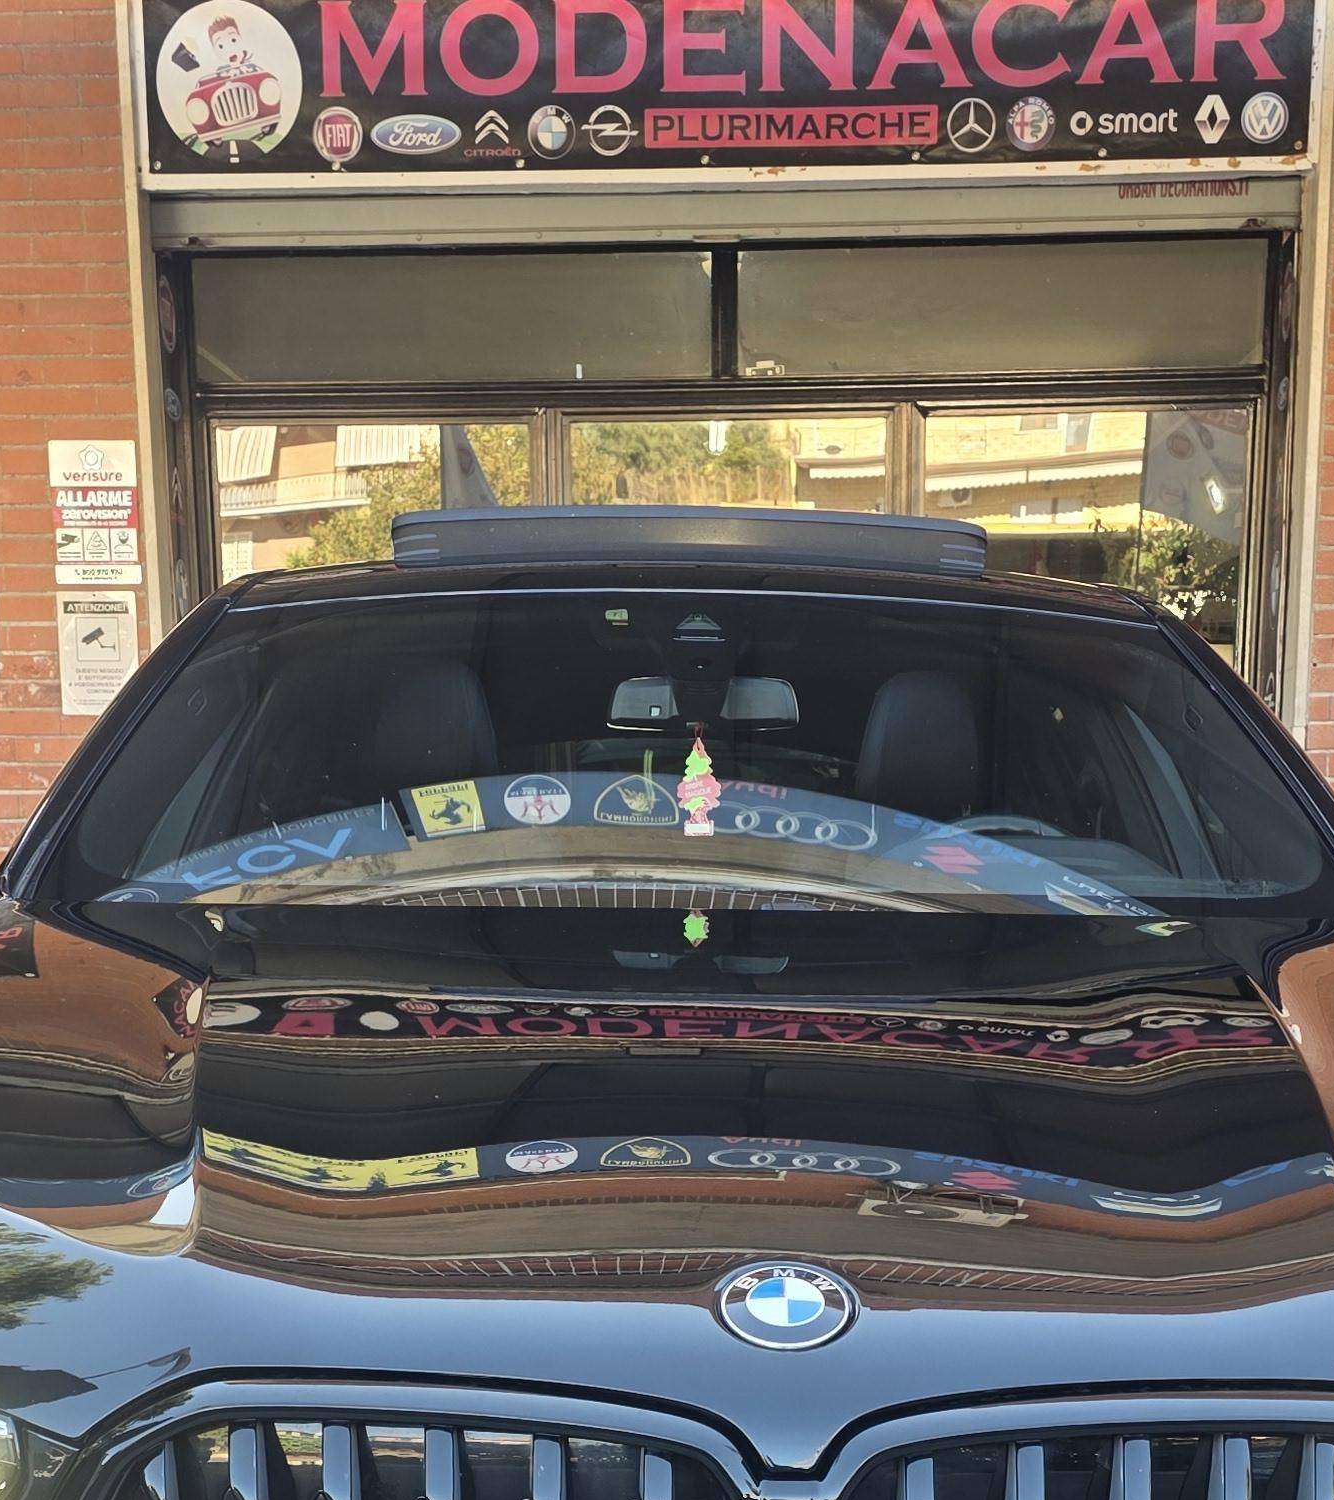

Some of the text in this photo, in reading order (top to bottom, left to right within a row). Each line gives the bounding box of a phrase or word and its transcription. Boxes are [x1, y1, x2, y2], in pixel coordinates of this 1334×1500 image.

[320, 0, 1287, 96] MODENACAR
[652, 110, 931, 142] PLURIMARCHE
[1098, 108, 1178, 134] smart
[325, 124, 352, 147] FIAT
[389, 121, 442, 147] Ford
[63, 471, 123, 482] verisure
[56, 490, 133, 507] ALLARME
[67, 602, 127, 612] ATTENZIONE!
[734, 1269, 836, 1290] BMW
